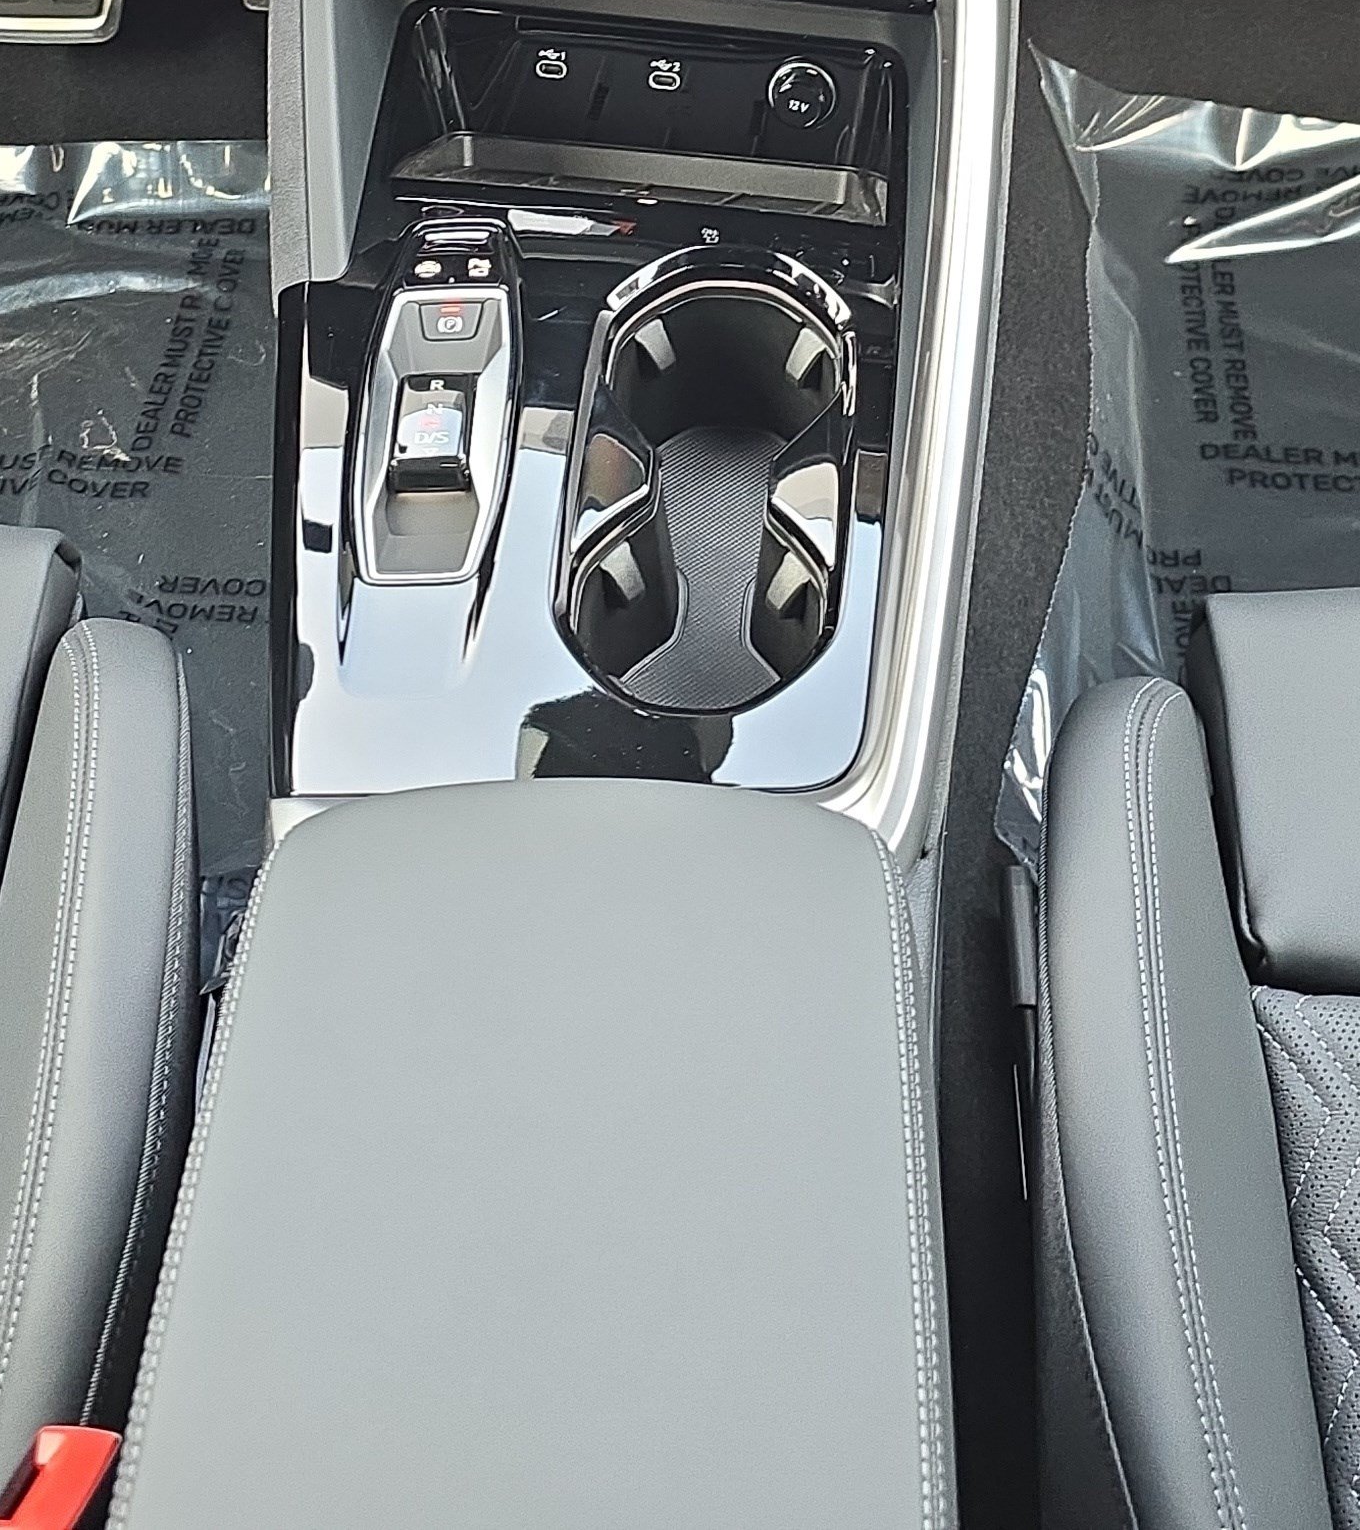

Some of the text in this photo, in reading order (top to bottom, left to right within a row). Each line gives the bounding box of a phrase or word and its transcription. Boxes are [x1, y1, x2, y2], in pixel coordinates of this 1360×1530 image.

[129, 313, 203, 452] DEALER MUST
[169, 317, 232, 439] PROTECTIVE
[429, 378, 445, 390] R
[1188, 356, 1220, 426] COVER
[414, 431, 450, 444] D/S
[1198, 442, 1326, 470] DEALER
[46, 468, 152, 500] COVER
[157, 574, 267, 598] COVER
